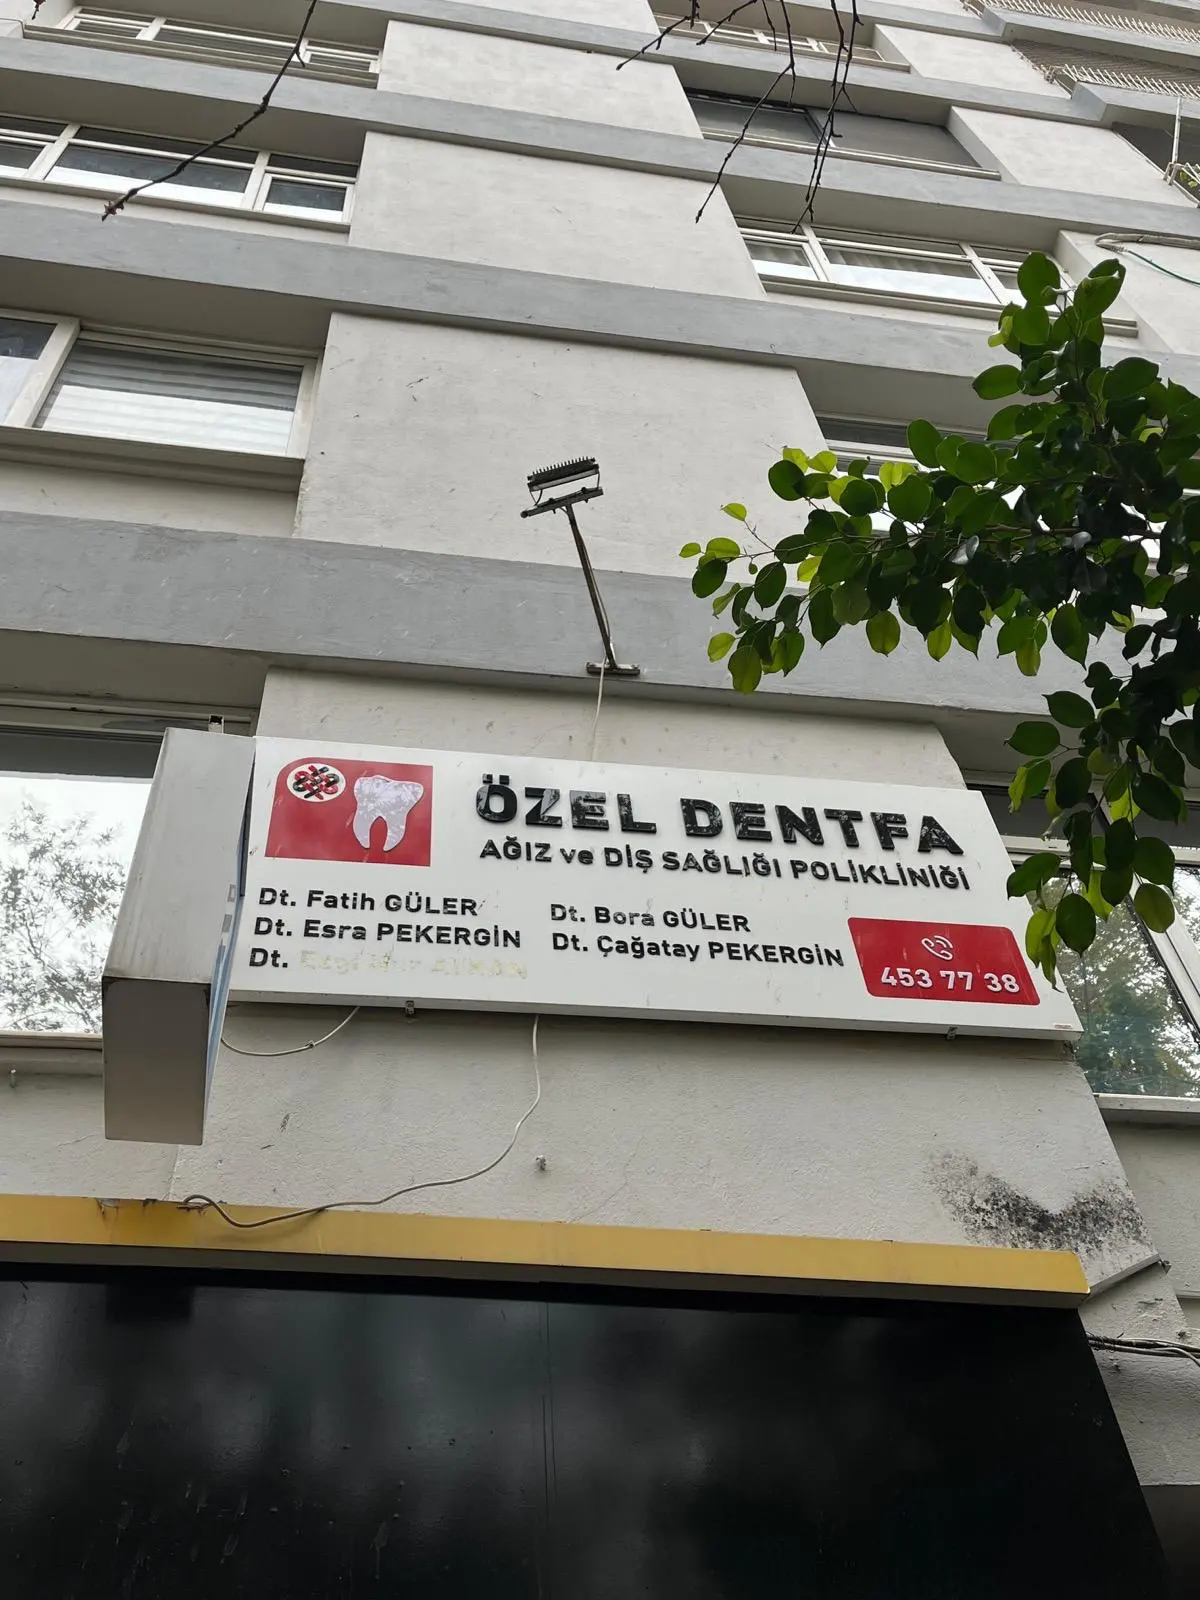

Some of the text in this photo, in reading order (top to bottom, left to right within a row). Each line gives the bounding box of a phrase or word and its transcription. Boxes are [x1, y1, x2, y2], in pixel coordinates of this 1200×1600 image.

[476, 773, 964, 856] ÖZEL DENTFA
[479, 835, 971, 891] AĞIZ ve DİŞ SAĞLIĞI POLİKLİNİĞİ
[259, 887, 478, 916] Dt. Fatih GÜLER
[254, 916, 521, 948] Dt. Esra PEKERGİN
[550, 903, 751, 932] Dt. Bora GÜLER
[249, 947, 289, 968] Dt.
[552, 932, 845, 967] Dt. Çağatay PEKERGİN
[880, 965, 1021, 994] 453 77 38
